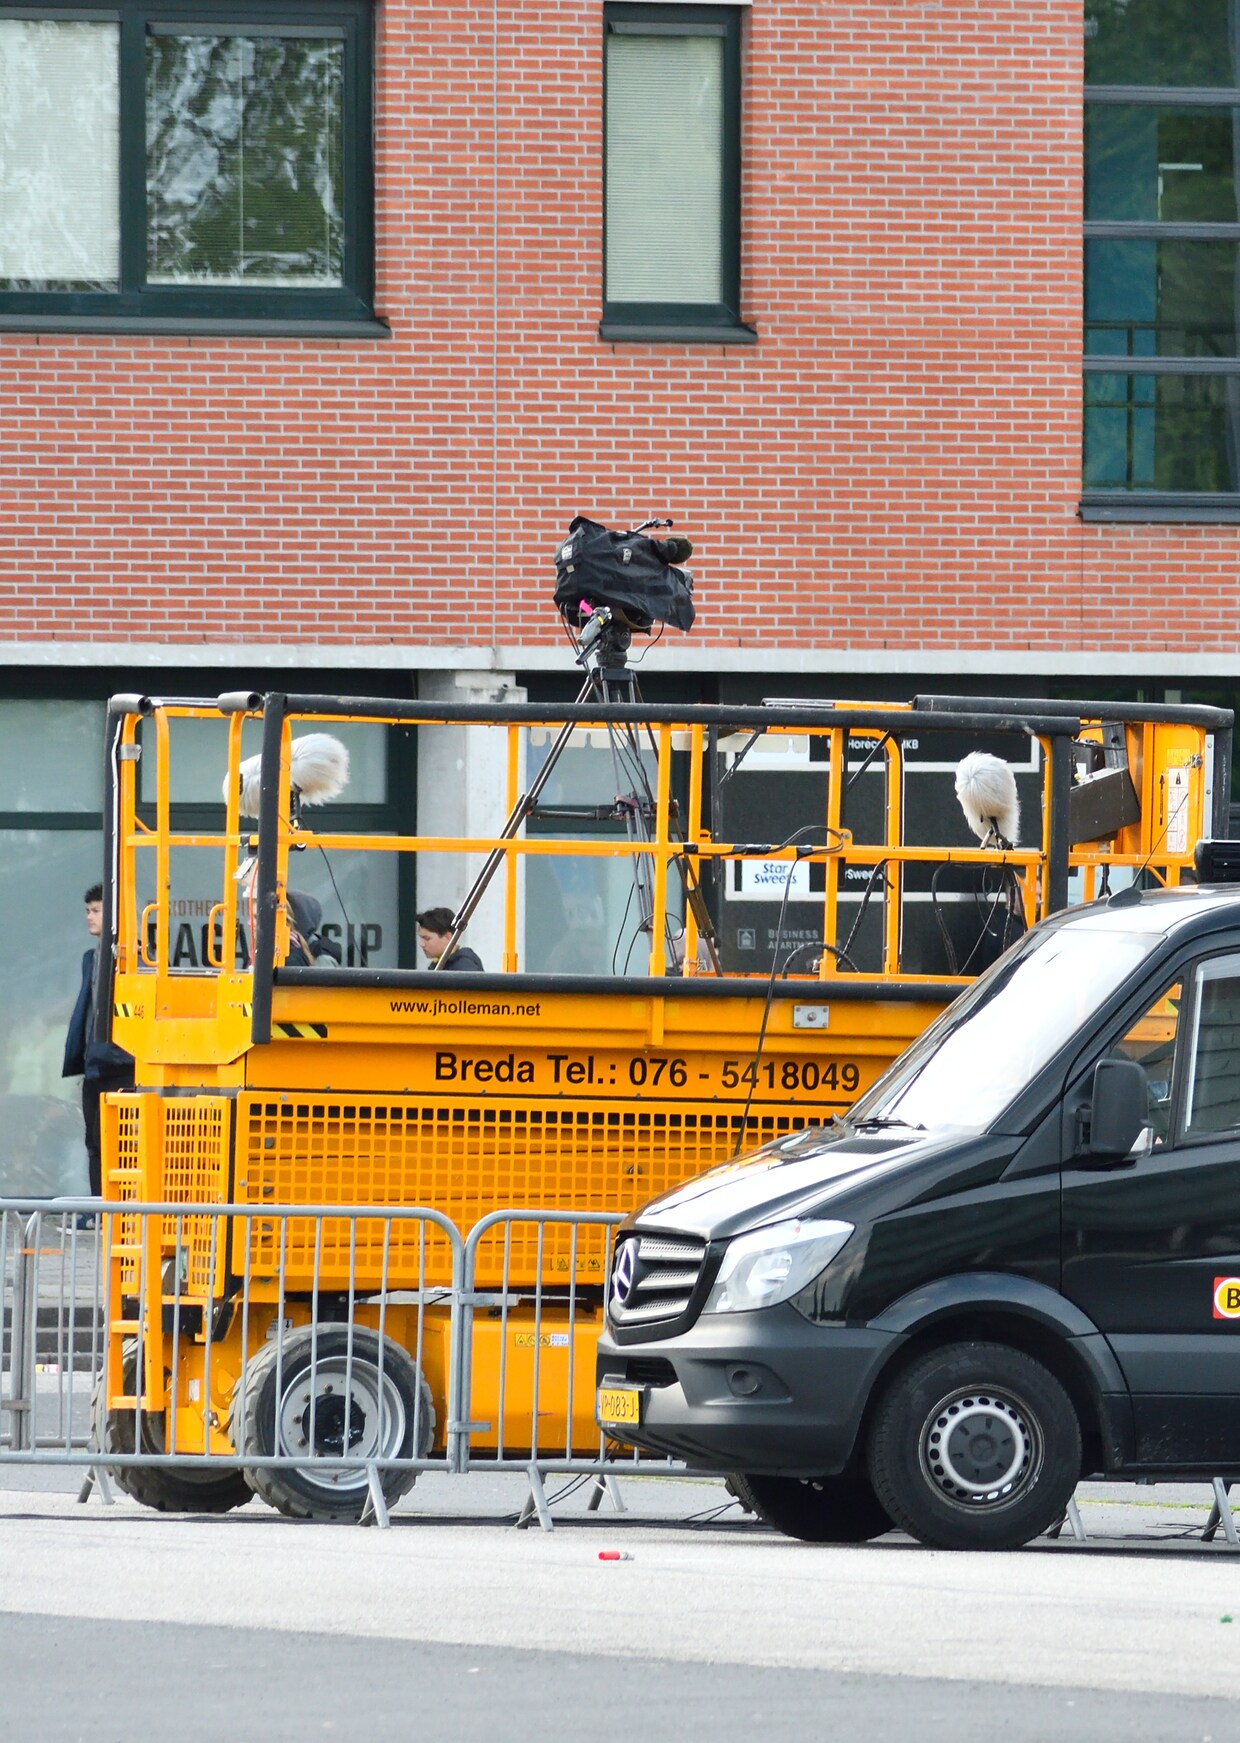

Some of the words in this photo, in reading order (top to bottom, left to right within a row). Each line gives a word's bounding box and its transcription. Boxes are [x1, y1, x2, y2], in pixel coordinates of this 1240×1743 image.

[763, 863, 788, 873] Star
[390, 1000, 541, 1017] www.jholleman.net
[435, 1052, 535, 1083] Breda
[546, 1054, 616, 1084] Tel.:
[629, 1057, 687, 1087] 076
[721, 1060, 860, 1092] 5418049
